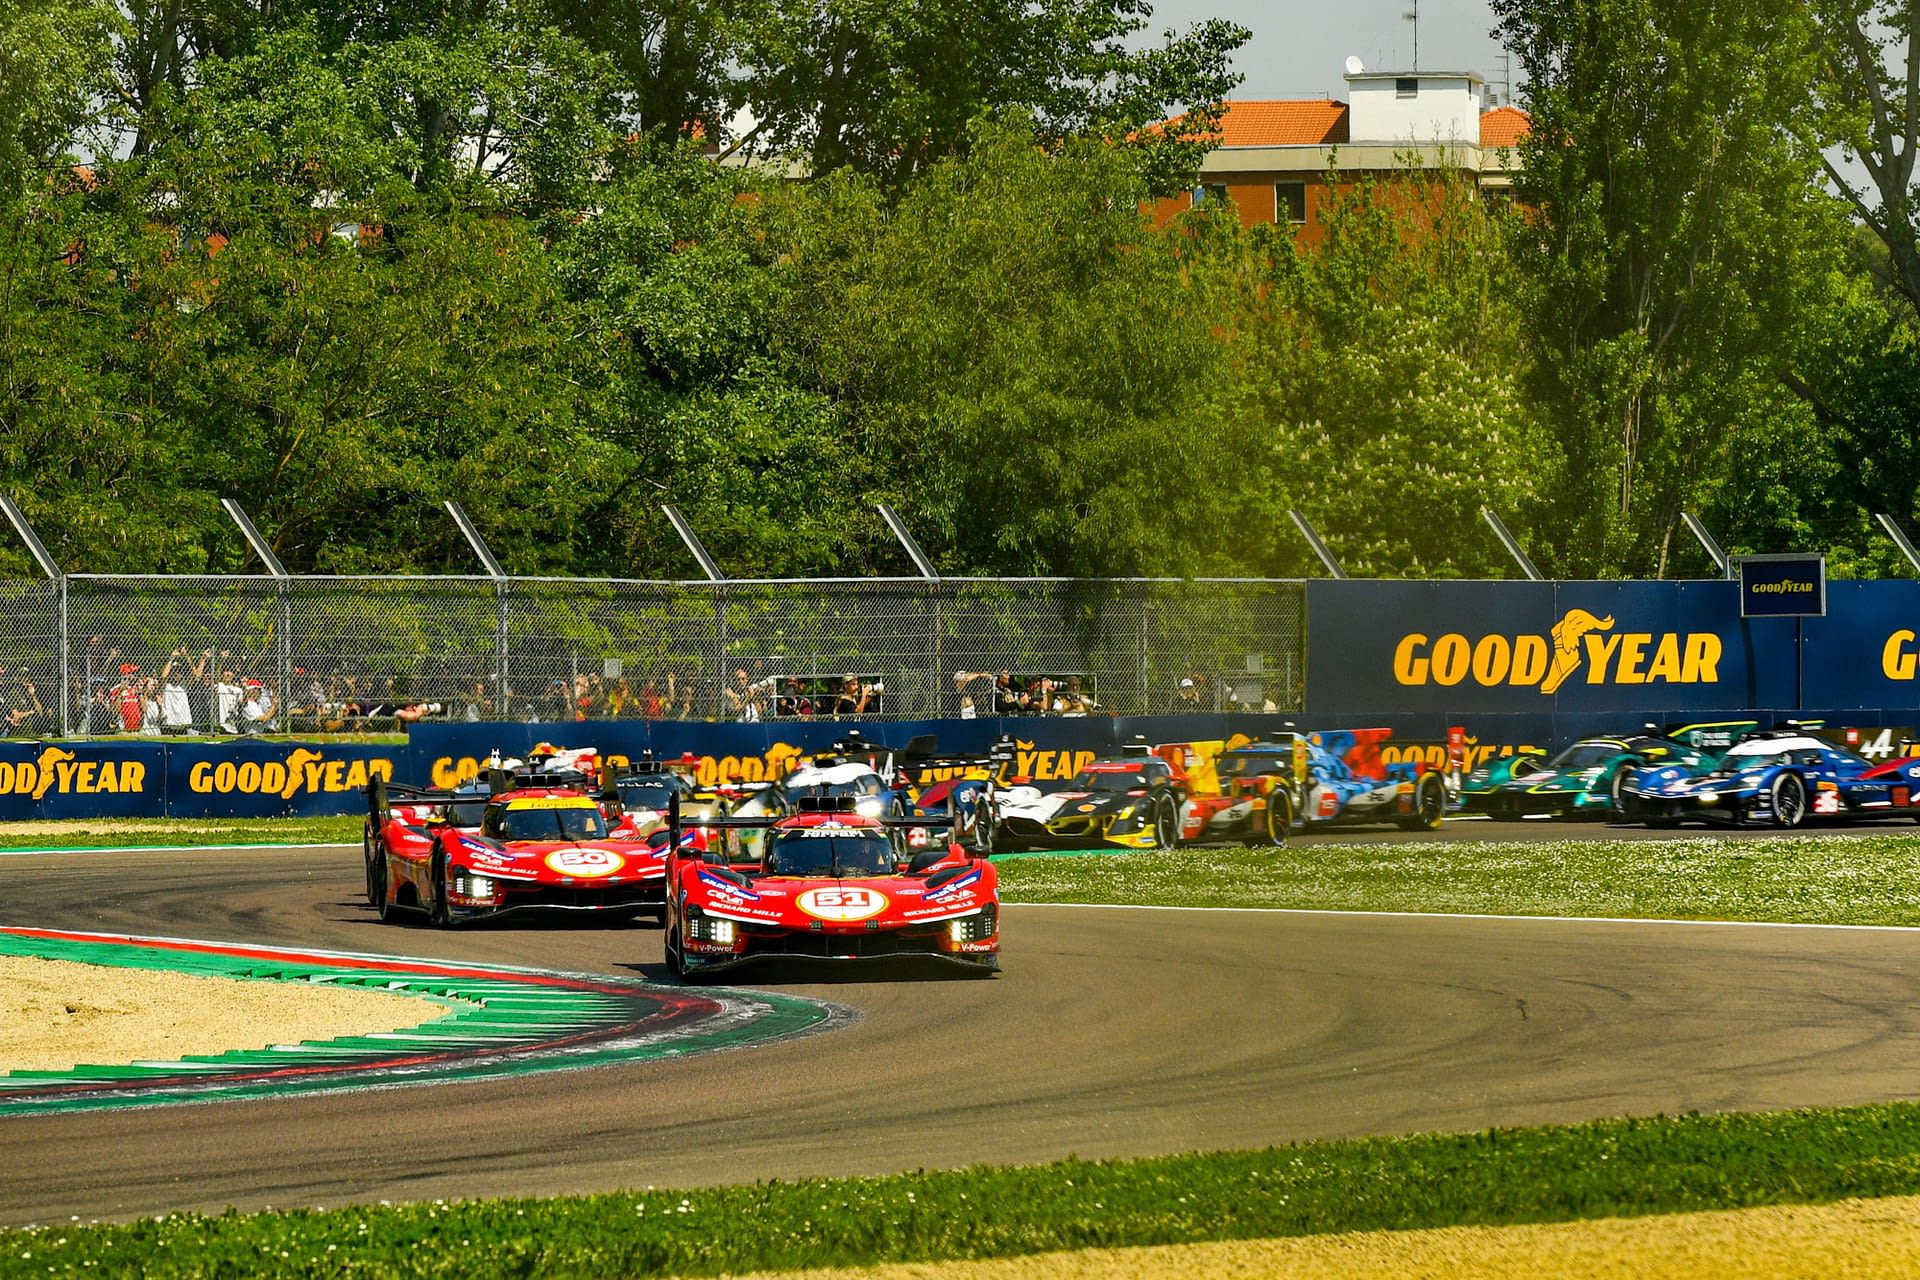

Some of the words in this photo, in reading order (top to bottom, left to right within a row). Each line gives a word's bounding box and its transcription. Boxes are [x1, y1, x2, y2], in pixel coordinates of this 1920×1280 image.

[1752, 581, 1813, 593] GOODYEAR
[1393, 632, 1723, 688] GOODYEAR
[801, 830, 866, 838] Ferrari
[561, 852, 608, 866] 50
[813, 891, 870, 906] 51
[708, 900, 752, 914] RICHARD
[752, 907, 784, 918] MILLE
[903, 905, 947, 918] RICHARD
[946, 899, 976, 911] MILLE
[699, 944, 735, 952] V-Power
[961, 943, 992, 952] V-Power
